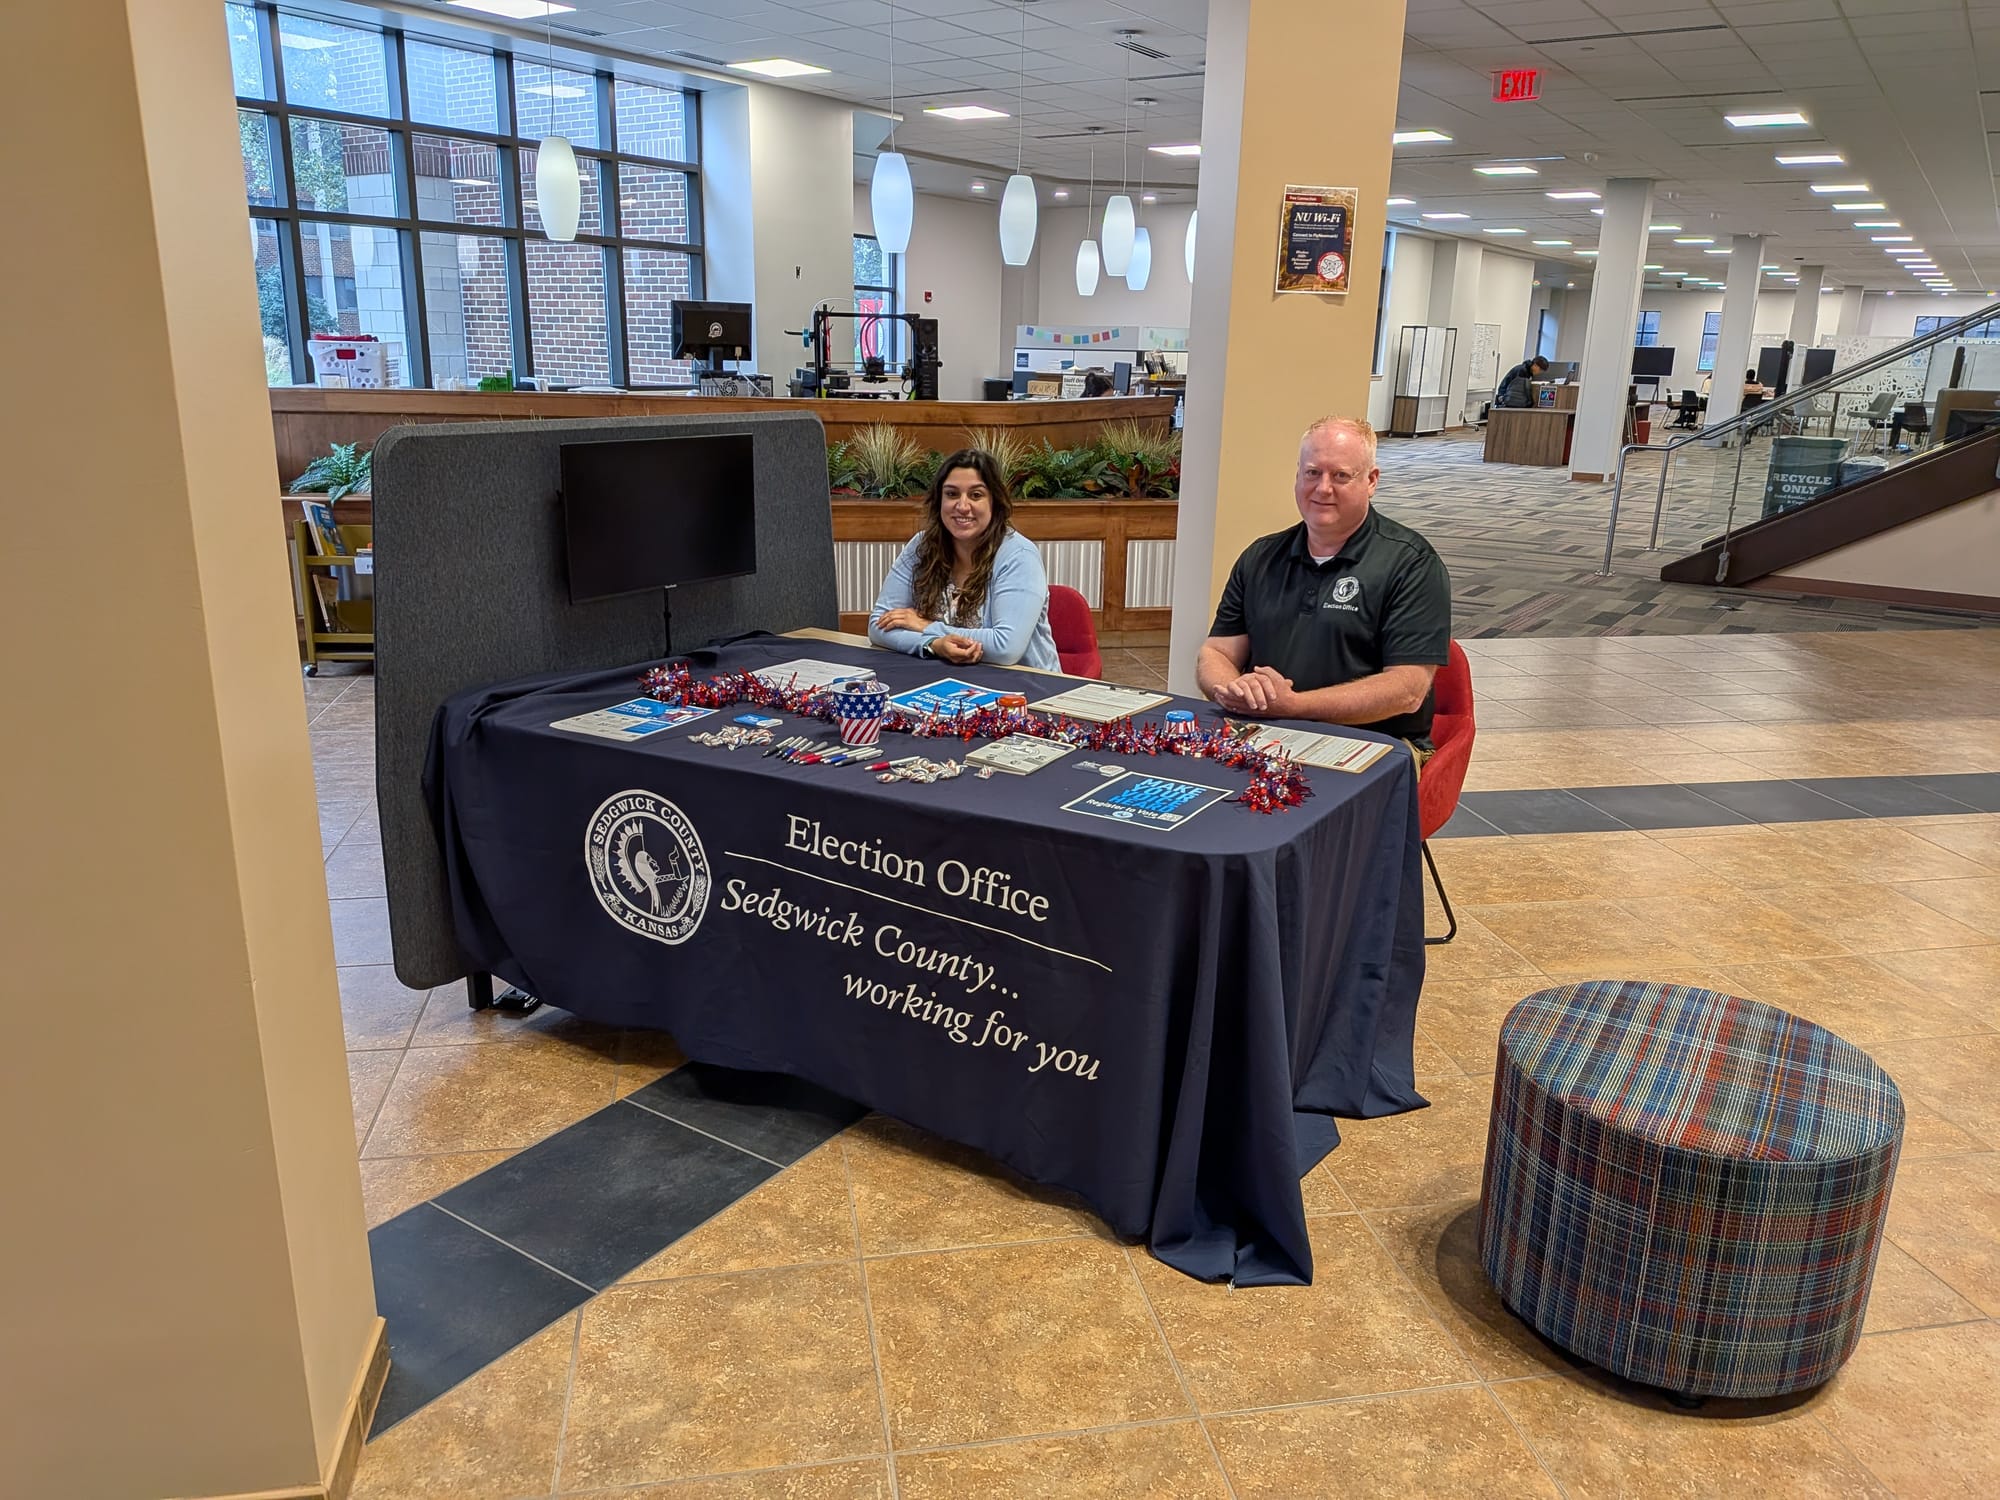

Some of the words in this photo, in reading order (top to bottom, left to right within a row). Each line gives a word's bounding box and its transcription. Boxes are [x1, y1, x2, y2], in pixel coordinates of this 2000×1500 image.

[1500, 71, 1537, 97] EXIT
[1294, 212, 1312, 222] NU
[1313, 212, 1342, 223] Wi-Fi
[1773, 473, 1833, 485] RECYCLE
[1782, 484, 1818, 495] ONLY
[1131, 783, 1199, 803] YOUR
[1139, 778, 1207, 797] MAKE
[1086, 798, 1126, 810] Register
[1137, 808, 1159, 817] Vote
[1108, 795, 1178, 813] HEARD
[1120, 789, 1187, 809] VOICE
[593, 797, 657, 846] SEDGWICK
[660, 806, 706, 874] COUNTY
[784, 813, 926, 887] Election
[936, 859, 1050, 922] Office
[623, 910, 679, 938] KANSAS
[720, 878, 865, 948] Sedgwick
[874, 924, 1019, 1000] County...
[843, 972, 974, 1044] working
[973, 1010, 1028, 1053] for
[1027, 1040, 1101, 1081] you
